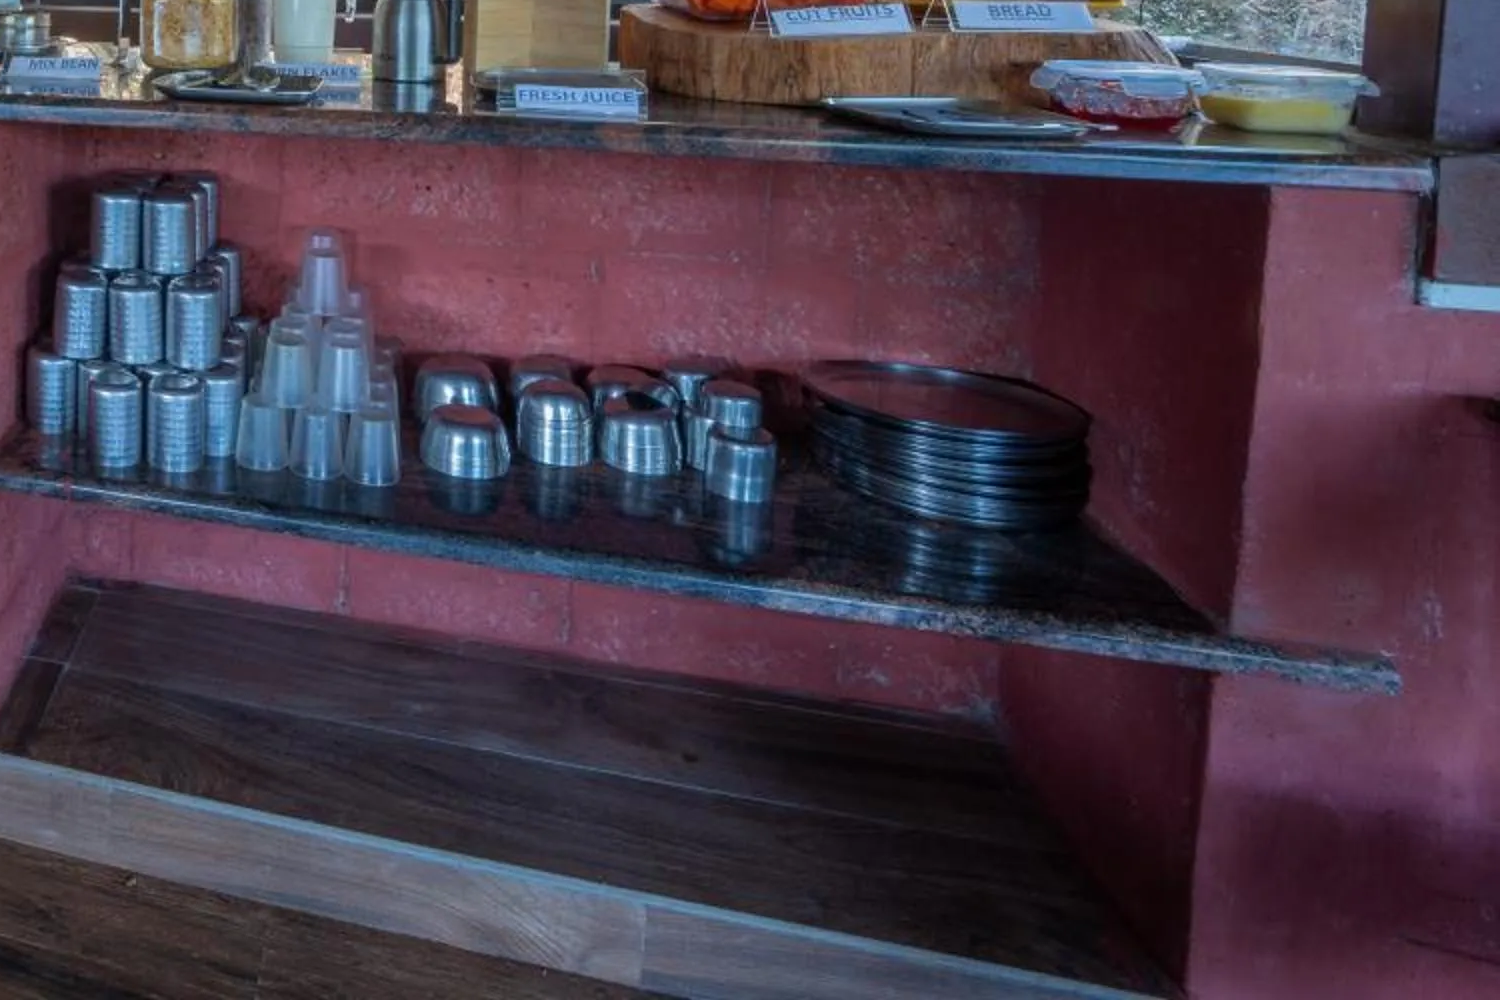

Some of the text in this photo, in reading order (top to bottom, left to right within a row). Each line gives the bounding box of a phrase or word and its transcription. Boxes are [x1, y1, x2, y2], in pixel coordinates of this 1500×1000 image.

[785, 3, 895, 22] CUT FRUITS
[987, 3, 1051, 17] BREAD
[60, 58, 99, 70] BEAN
[303, 66, 358, 79] FLAKES
[518, 88, 635, 105] FRESH JUICE
